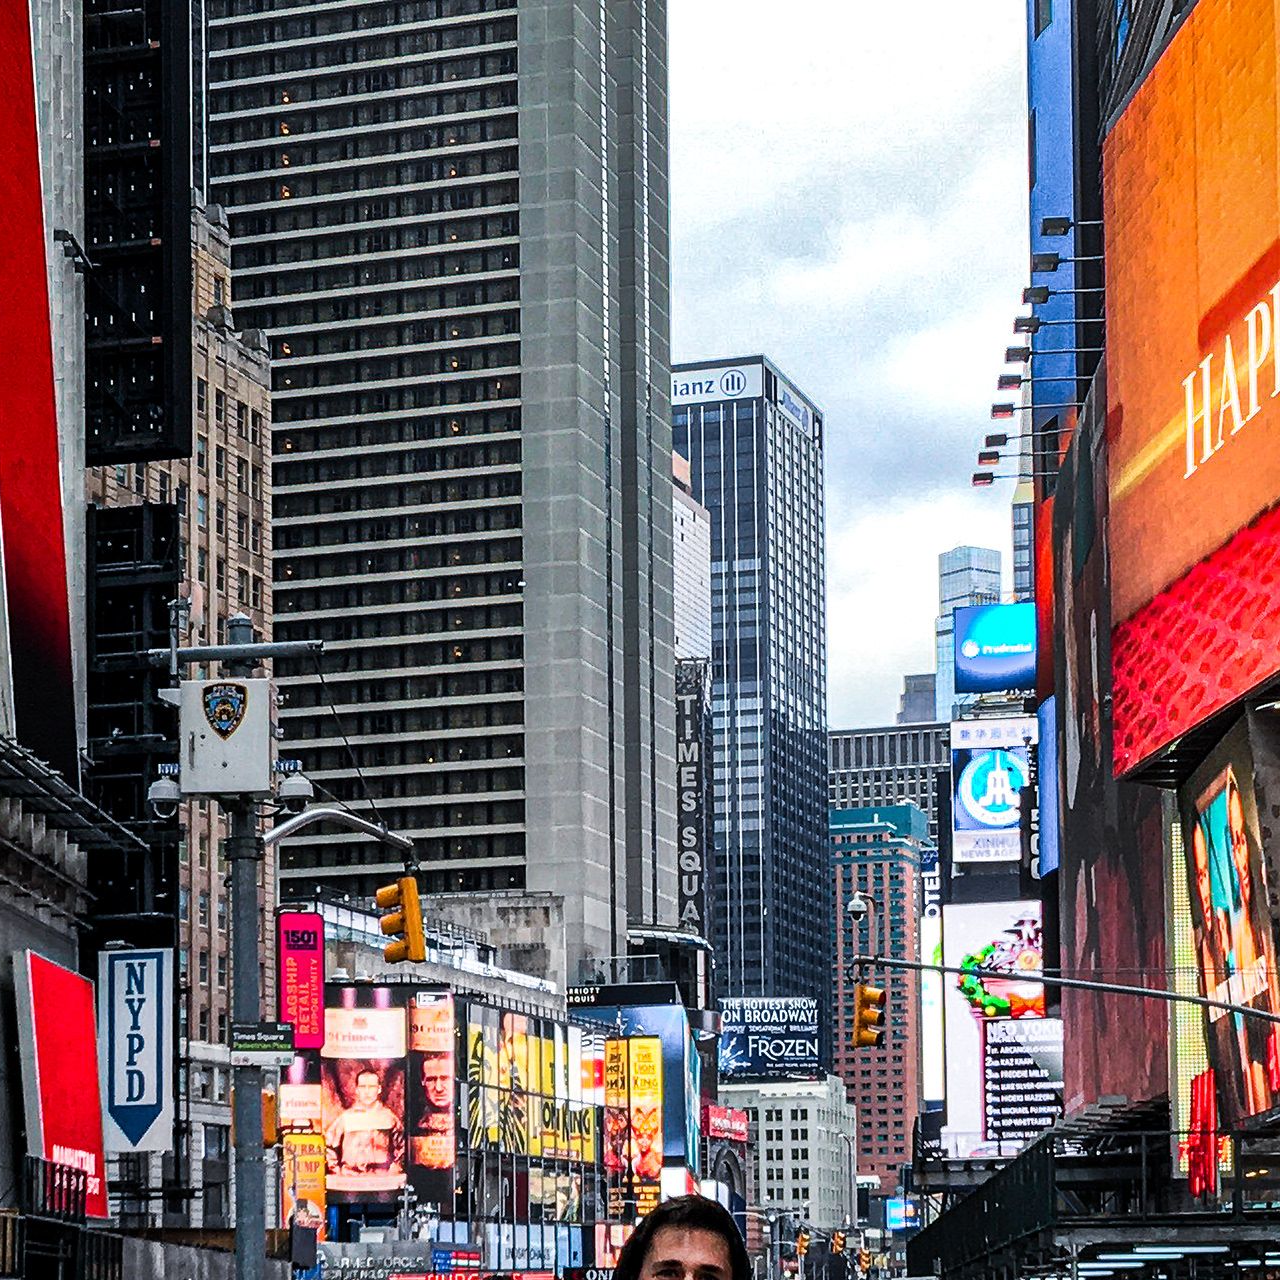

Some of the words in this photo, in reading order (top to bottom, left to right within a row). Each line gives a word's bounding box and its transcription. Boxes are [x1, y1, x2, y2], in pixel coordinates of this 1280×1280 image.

[677, 694, 699, 812] TIMES
[961, 850, 991, 859] NEWS
[284, 930, 318, 943] 1501
[286, 956, 298, 1033] LAGSHIP
[310, 958, 320, 1035] OPPORTUNITY
[723, 1000, 741, 1009] THE
[744, 1000, 785, 1009] HOTTEST
[789, 999, 817, 1009] SNOW
[299, 982, 310, 1034] RETAIL
[722, 1010, 741, 1022] ON
[125, 962, 147, 1102] NYPD
[233, 1032, 256, 1040] Times
[256, 1032, 285, 1041] Square
[987, 1022, 1017, 1036] NEO
[748, 1035, 819, 1061] FROZEN
